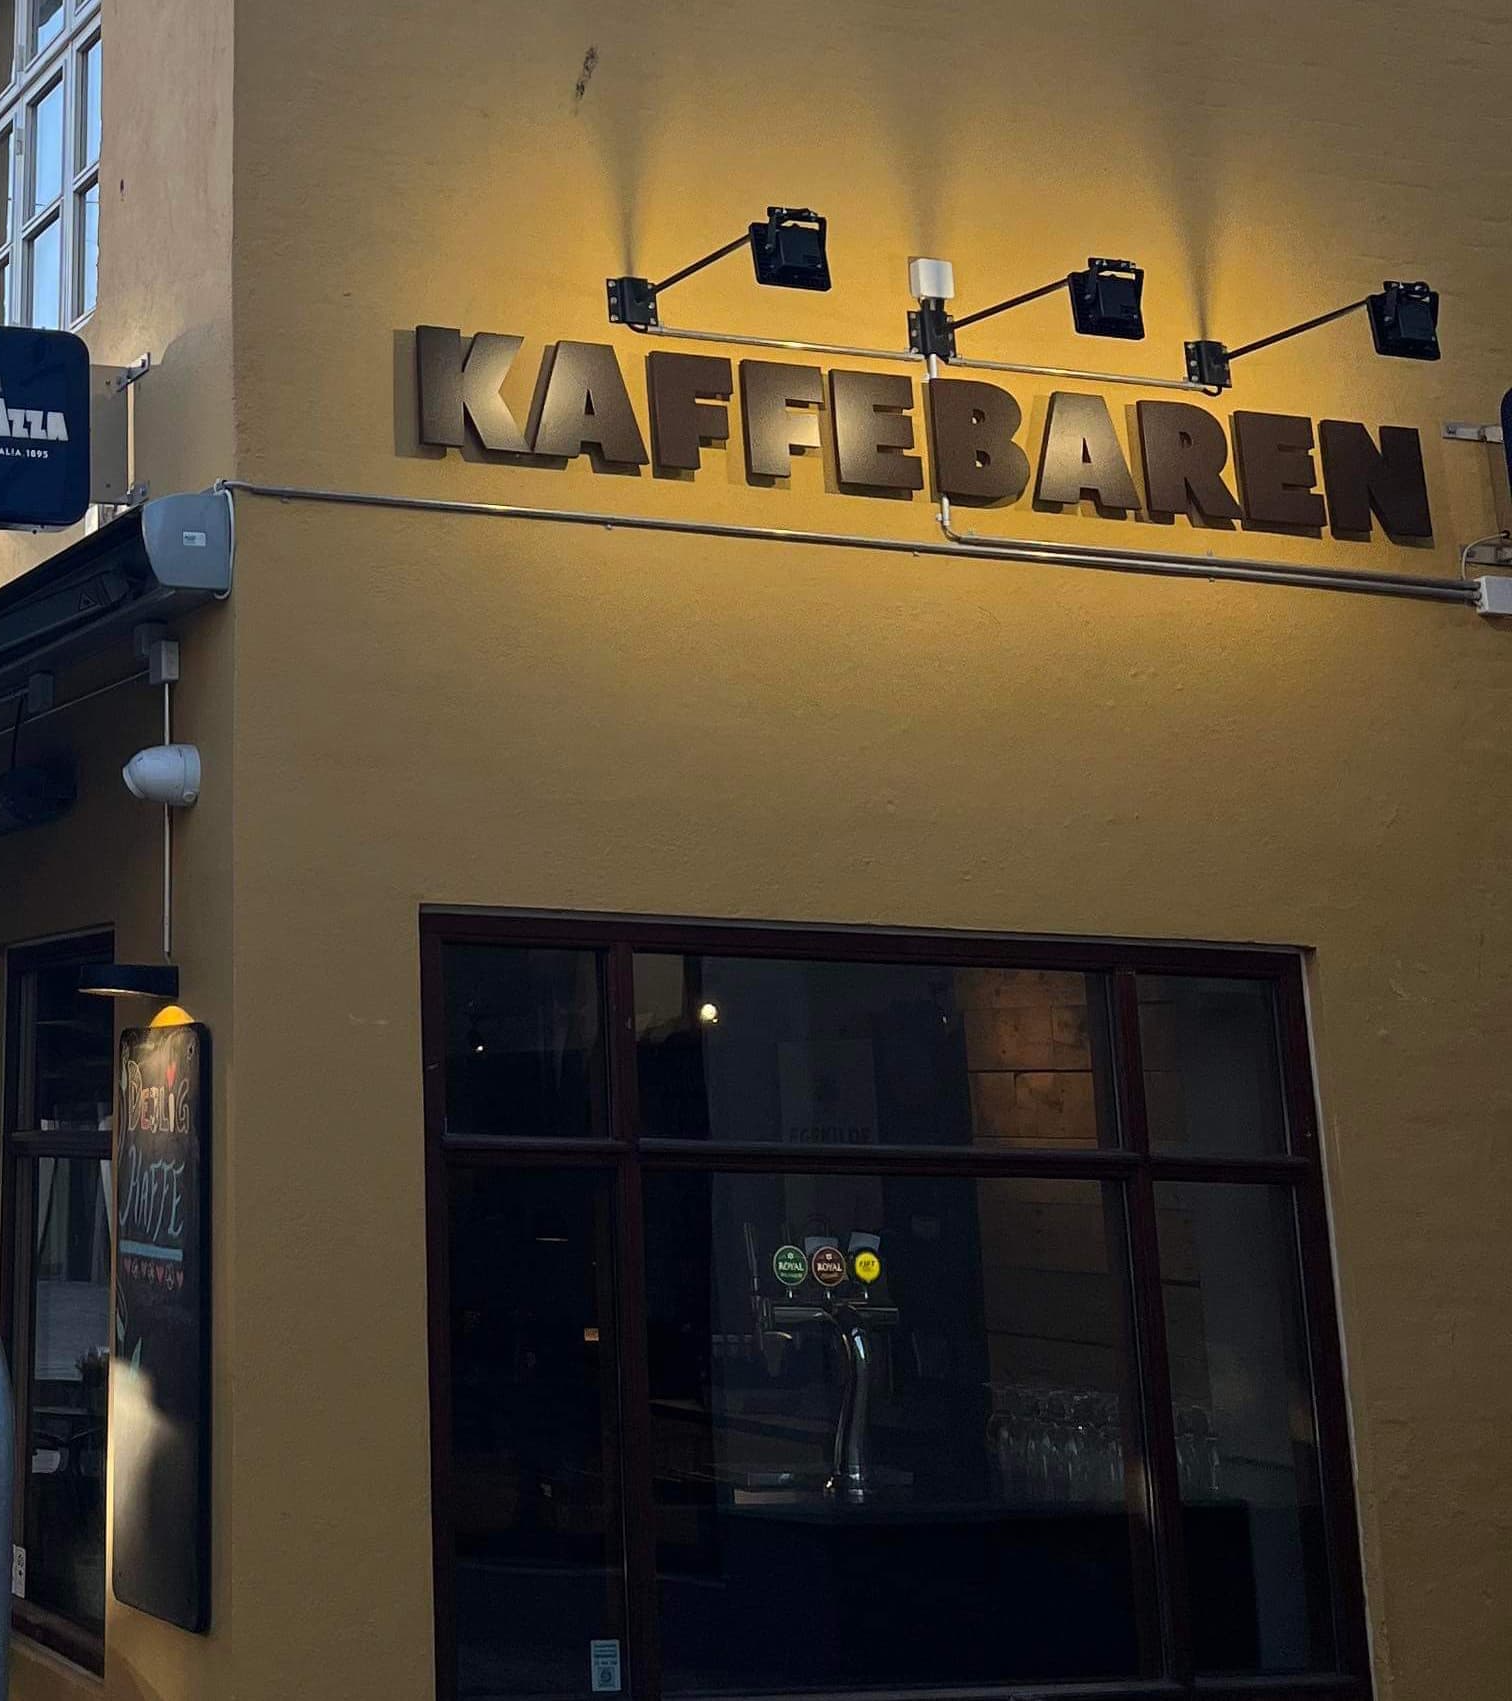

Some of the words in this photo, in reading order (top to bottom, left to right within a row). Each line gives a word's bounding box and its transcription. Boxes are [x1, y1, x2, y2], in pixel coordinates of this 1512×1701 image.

[416, 326, 1433, 538] KAFFEBAREN
[26, 449, 49, 459] 1895
[119, 1145, 186, 1242] KAFFE
[778, 1262, 804, 1272] ROYAL
[817, 1262, 843, 1273] ROYAL
